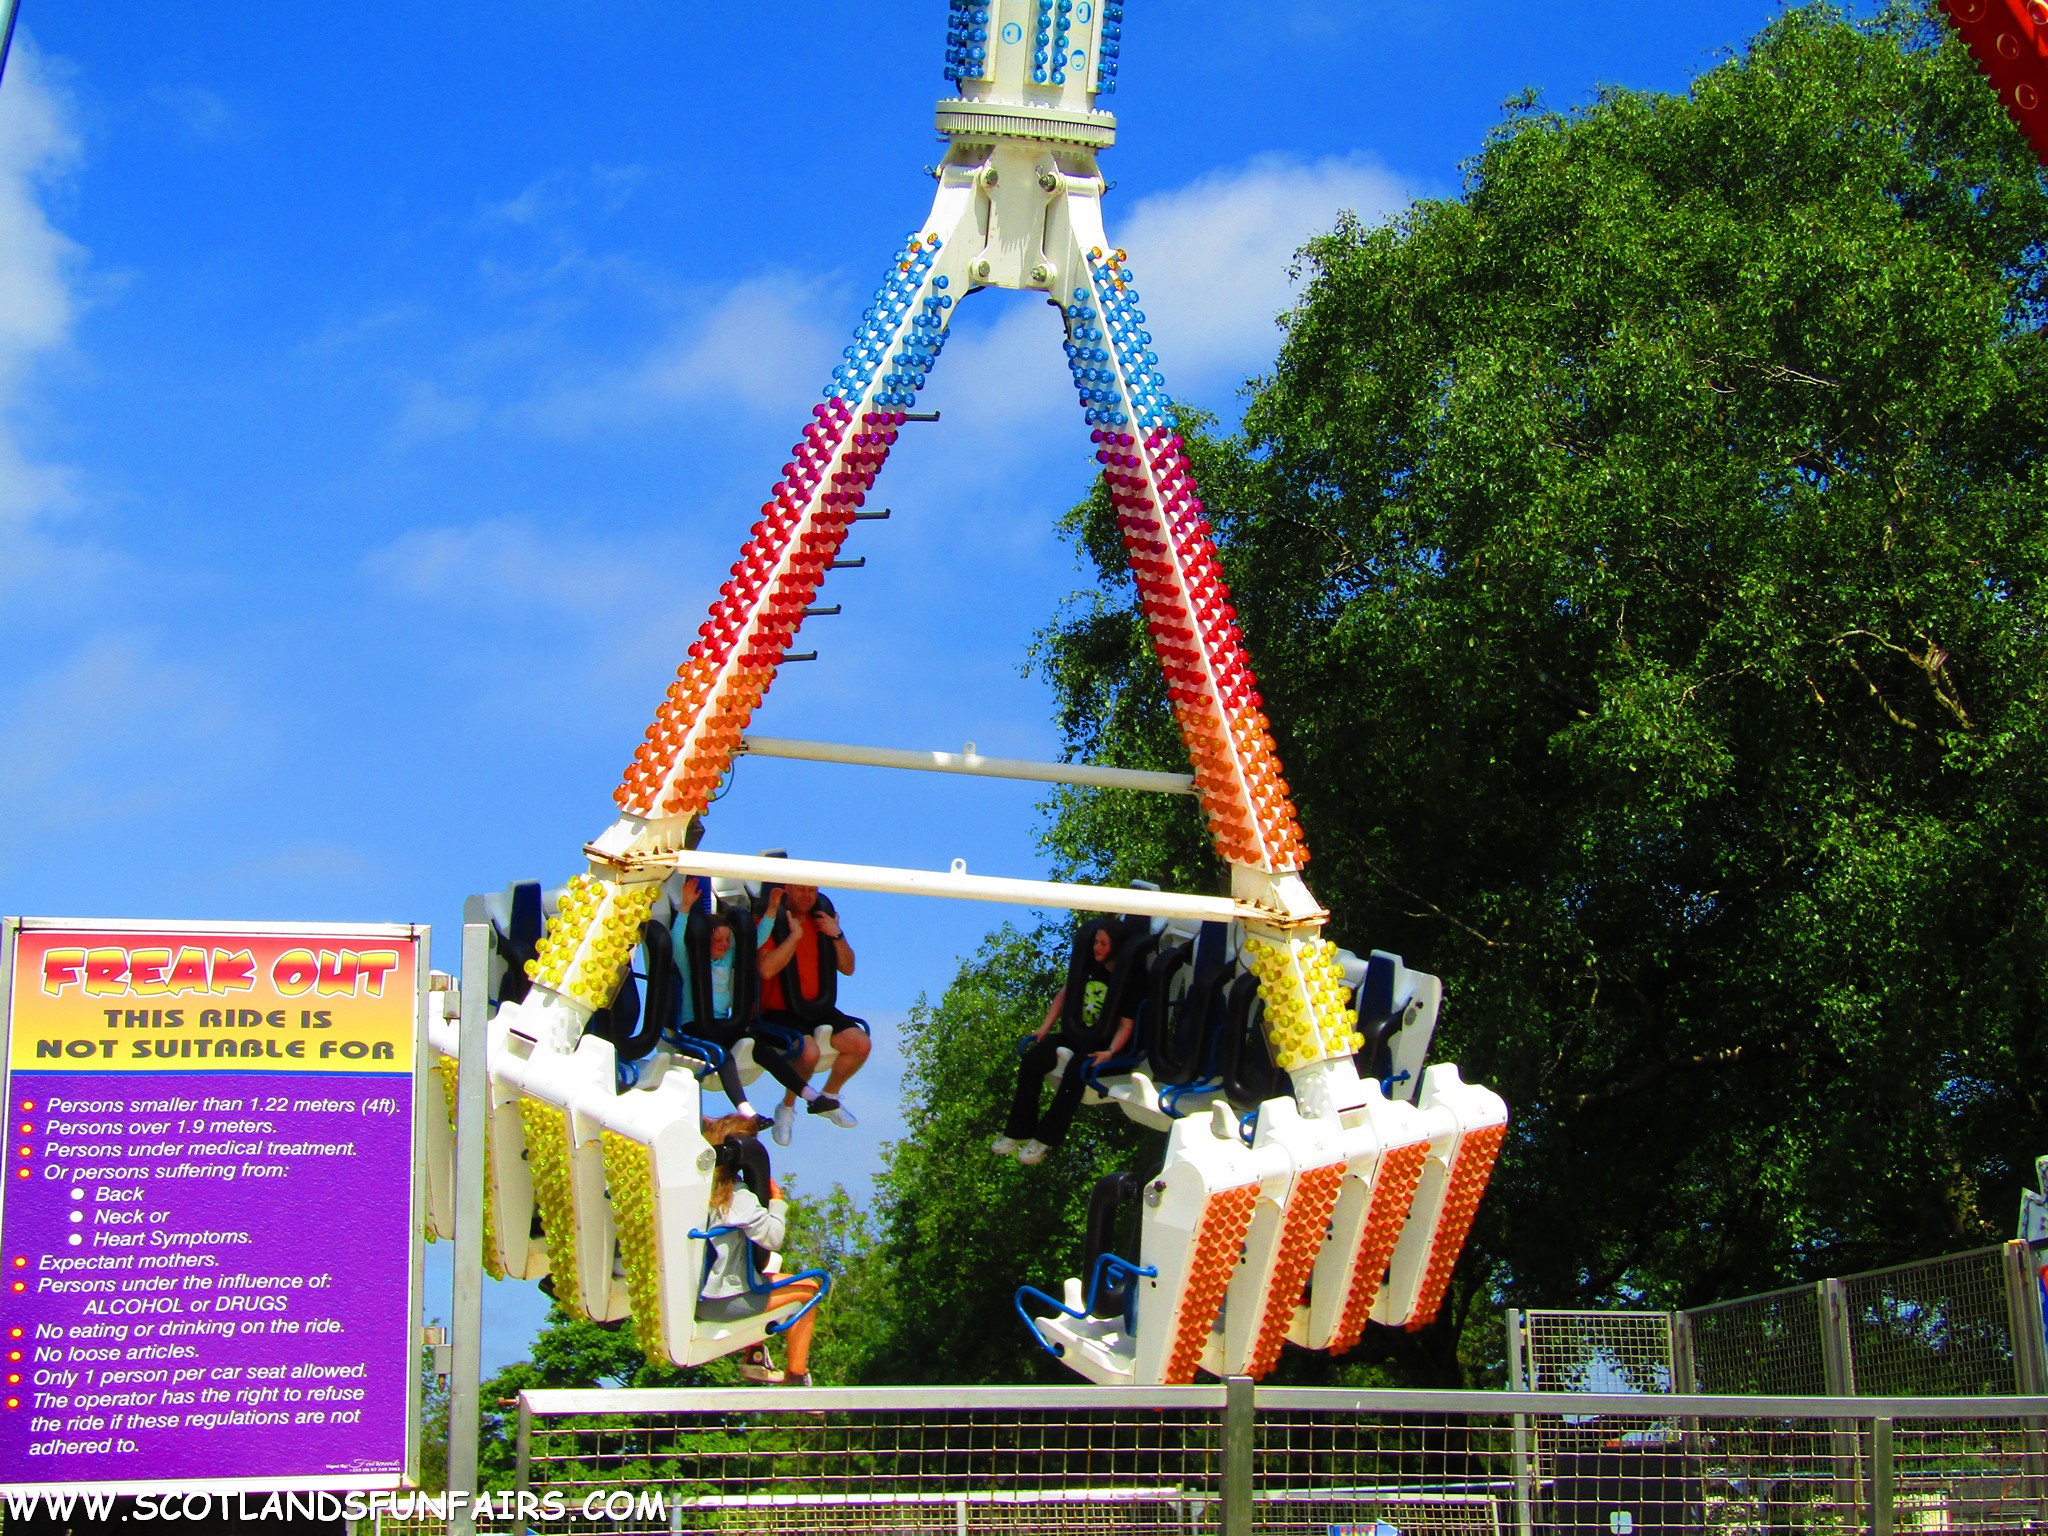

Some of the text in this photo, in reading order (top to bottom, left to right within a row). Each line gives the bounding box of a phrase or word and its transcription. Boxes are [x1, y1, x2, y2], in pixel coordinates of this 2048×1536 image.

[43, 946, 399, 999] FREAK OUT
[103, 1009, 333, 1030] THIS RIDE IS
[36, 1038, 396, 1061] NOT SUITABLE FOR
[46, 1096, 401, 1117] Persons smaller than 1.22 meters (4ft).
[45, 1118, 277, 1136] Persons over 1.9 meters.
[44, 1139, 357, 1158] Persons under medical treatment.
[43, 1161, 290, 1184] Or persons suffering from:
[95, 1186, 145, 1202] Back
[93, 1208, 171, 1225] Neck or
[92, 1229, 253, 1250] Heart Symptoms.
[38, 1252, 220, 1274] Expectant mothers.
[37, 1272, 333, 1293] Persons under the influence of:
[82, 1295, 288, 1315] ALCOHOL or DRUGS
[35, 1317, 345, 1342] No eating or drinking on the ride.
[33, 1343, 200, 1362] No loose articles.
[33, 1362, 368, 1389] Only 1 person per car seat allowed.
[33, 1385, 365, 1412] The operator has the right to refuse
[30, 1408, 362, 1432] the ride if these regulations are not
[28, 1437, 139, 1456] adhered to.
